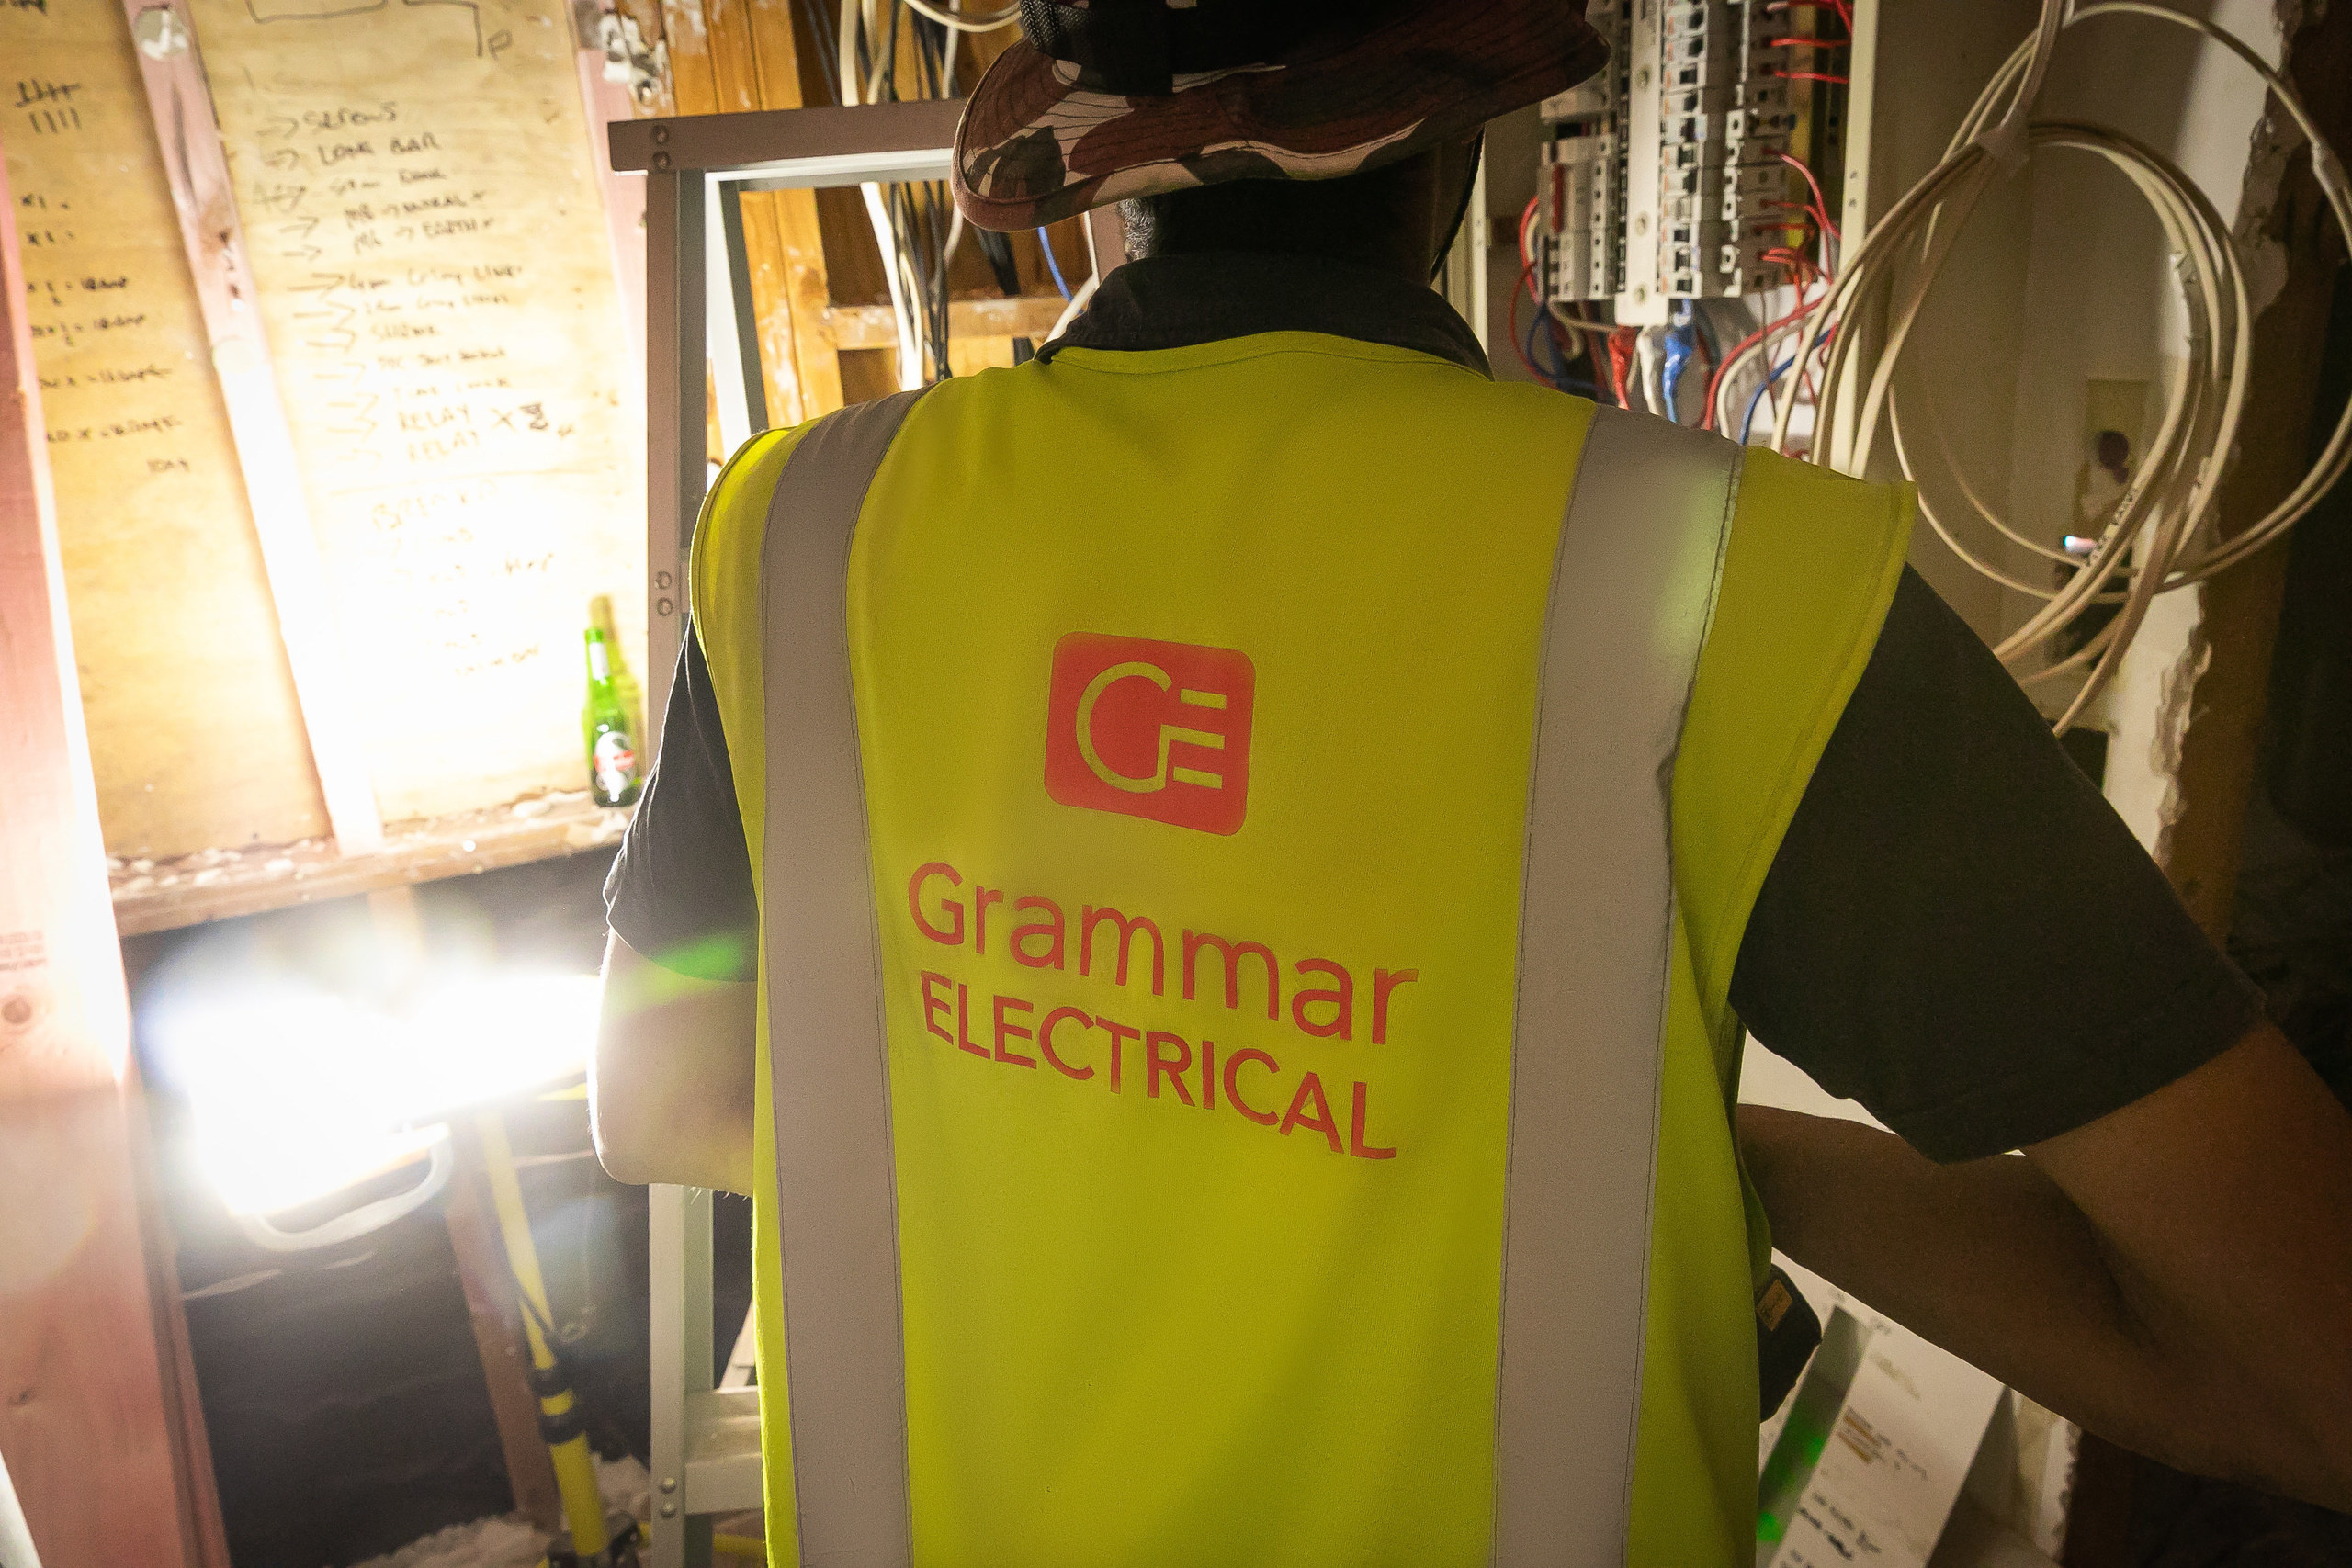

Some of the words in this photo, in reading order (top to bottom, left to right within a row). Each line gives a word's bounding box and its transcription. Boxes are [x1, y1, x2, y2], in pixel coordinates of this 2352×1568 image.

[397, 402, 473, 433] RELAY
[406, 428, 480, 463] RELAY
[1076, 660, 1227, 794] GE
[908, 862, 1419, 1045] Grammar
[921, 969, 1398, 1160] ELECTRICAL
